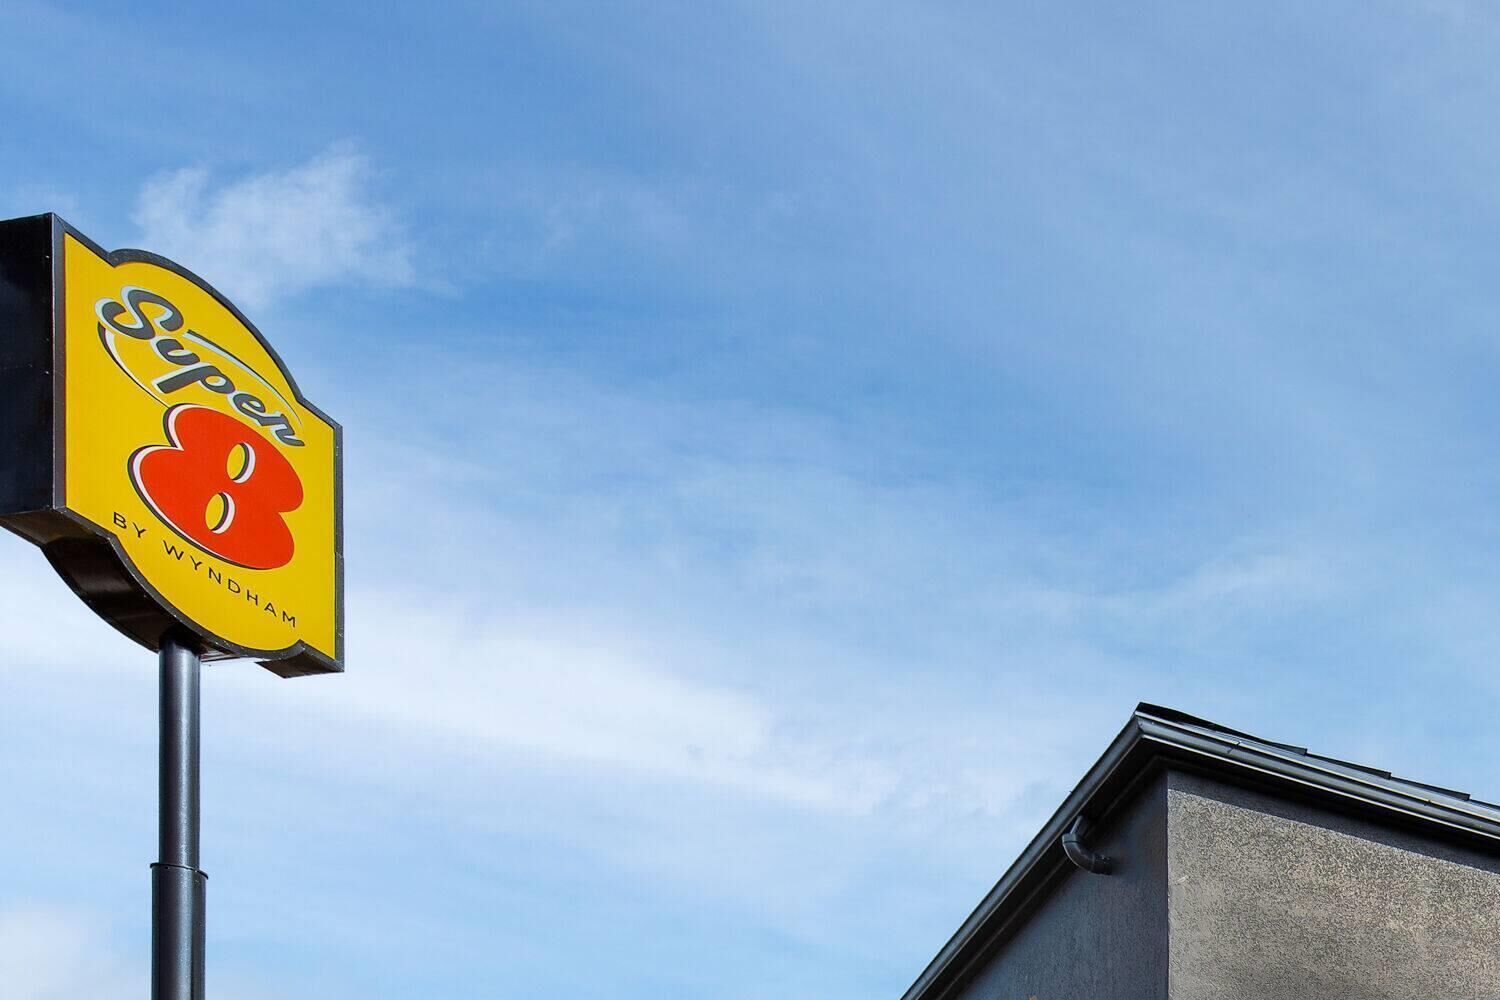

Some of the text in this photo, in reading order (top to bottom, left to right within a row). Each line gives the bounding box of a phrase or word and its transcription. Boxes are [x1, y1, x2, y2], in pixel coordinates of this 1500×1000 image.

[95, 285, 305, 446] Super
[127, 402, 304, 570] 8
[113, 511, 296, 628] BY WYNDHAM
